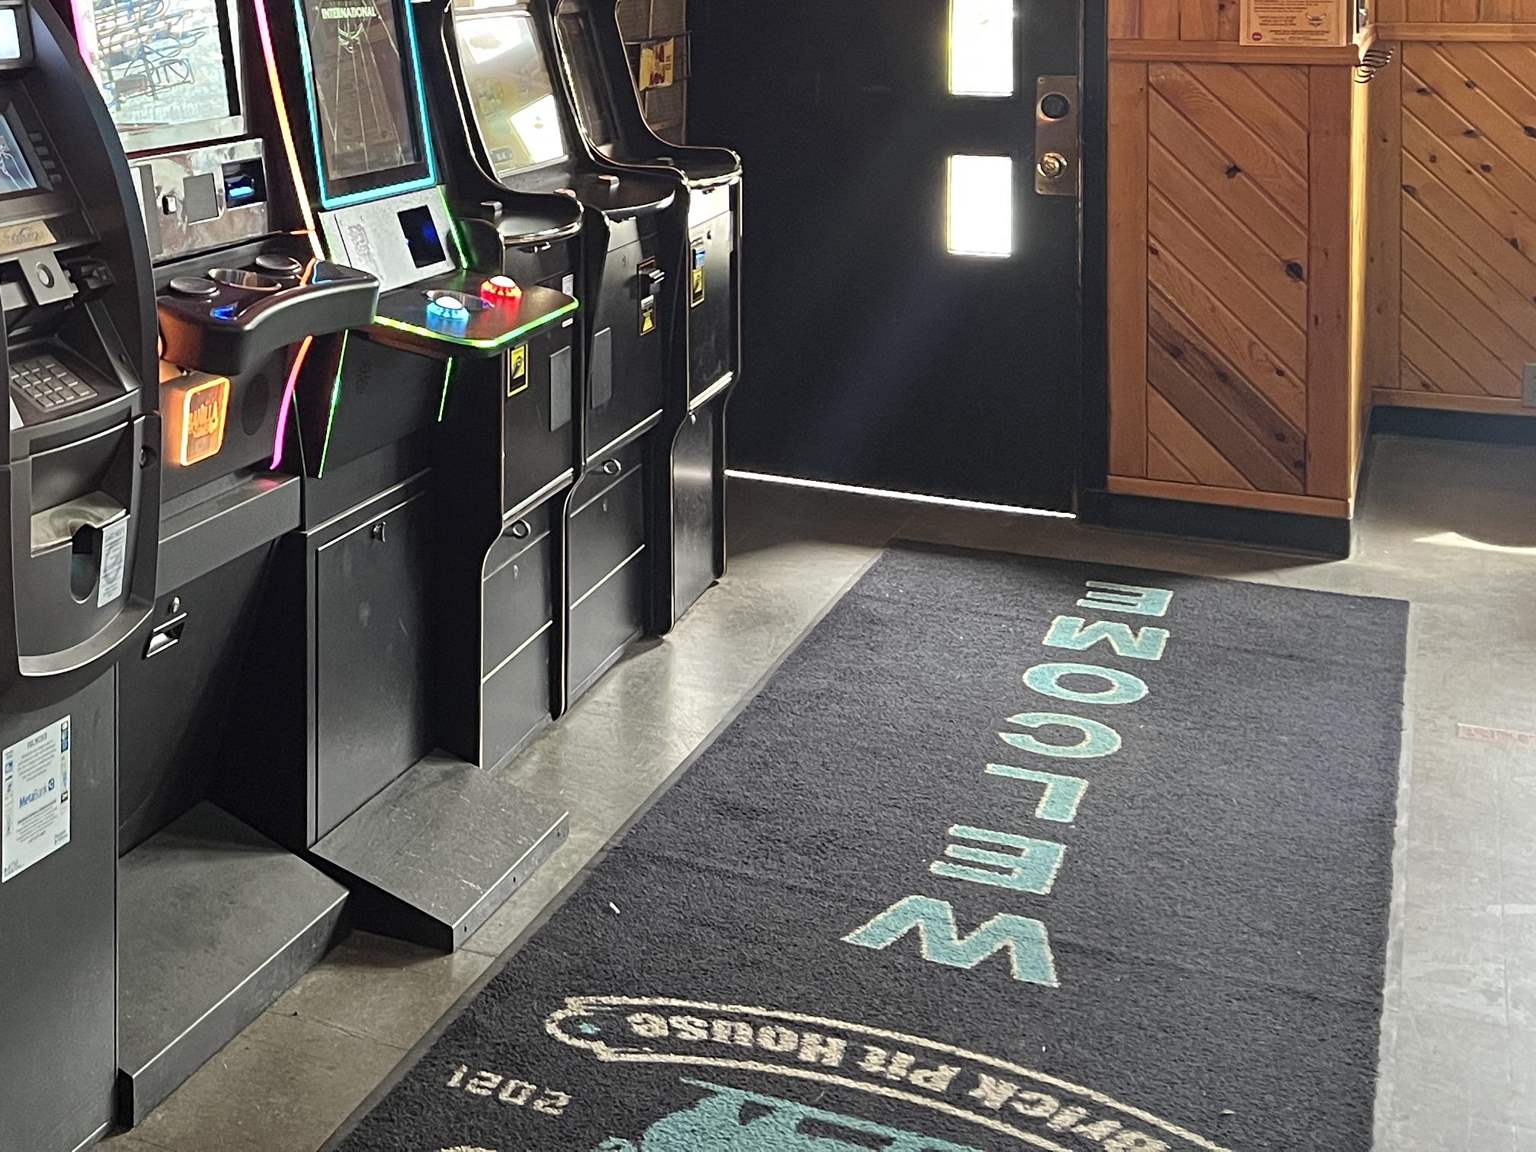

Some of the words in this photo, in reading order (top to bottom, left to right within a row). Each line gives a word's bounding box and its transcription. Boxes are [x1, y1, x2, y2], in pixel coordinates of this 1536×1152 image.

[321, 6, 377, 20] INTERNATIONAL
[840, 580, 1174, 988] WELCOME
[626, 1011, 848, 1068] House
[445, 1064, 573, 1115] 2021
[858, 1045, 962, 1093] Pit
